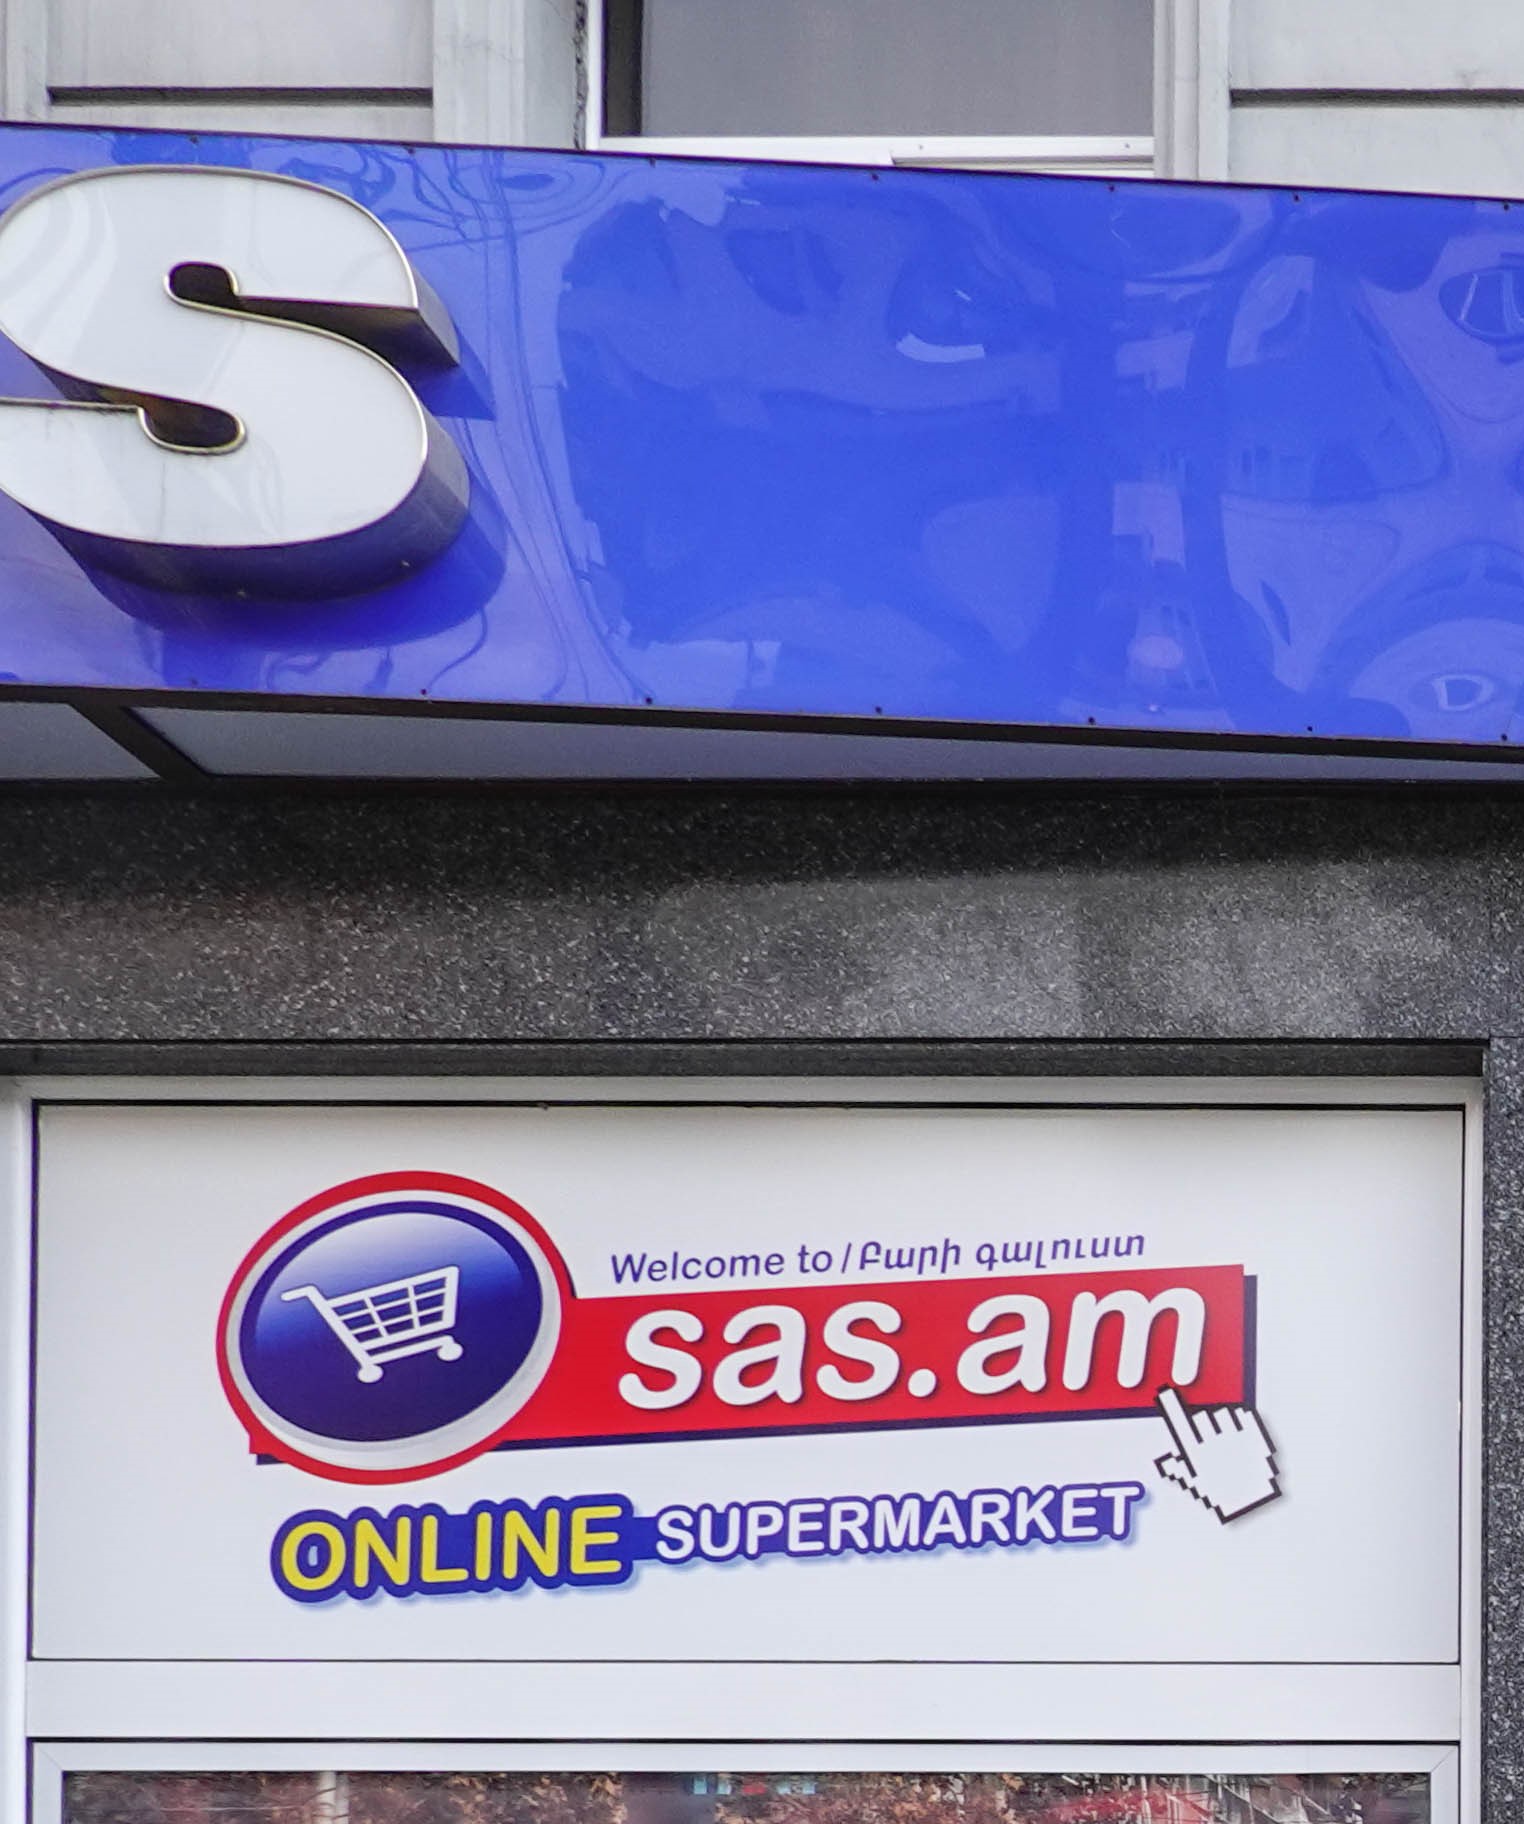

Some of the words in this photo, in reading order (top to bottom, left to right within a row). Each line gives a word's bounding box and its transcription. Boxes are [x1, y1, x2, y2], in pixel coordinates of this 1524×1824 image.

[610, 1250, 785, 1284] Welcome
[798, 1243, 833, 1274] to
[859, 1237, 961, 1275] Բարի
[975, 1233, 1146, 1269] գալուստ
[617, 1283, 1210, 1412] sas.am
[279, 1502, 627, 1591] ONLINE
[653, 1483, 1144, 1561] SUPERMARKET
